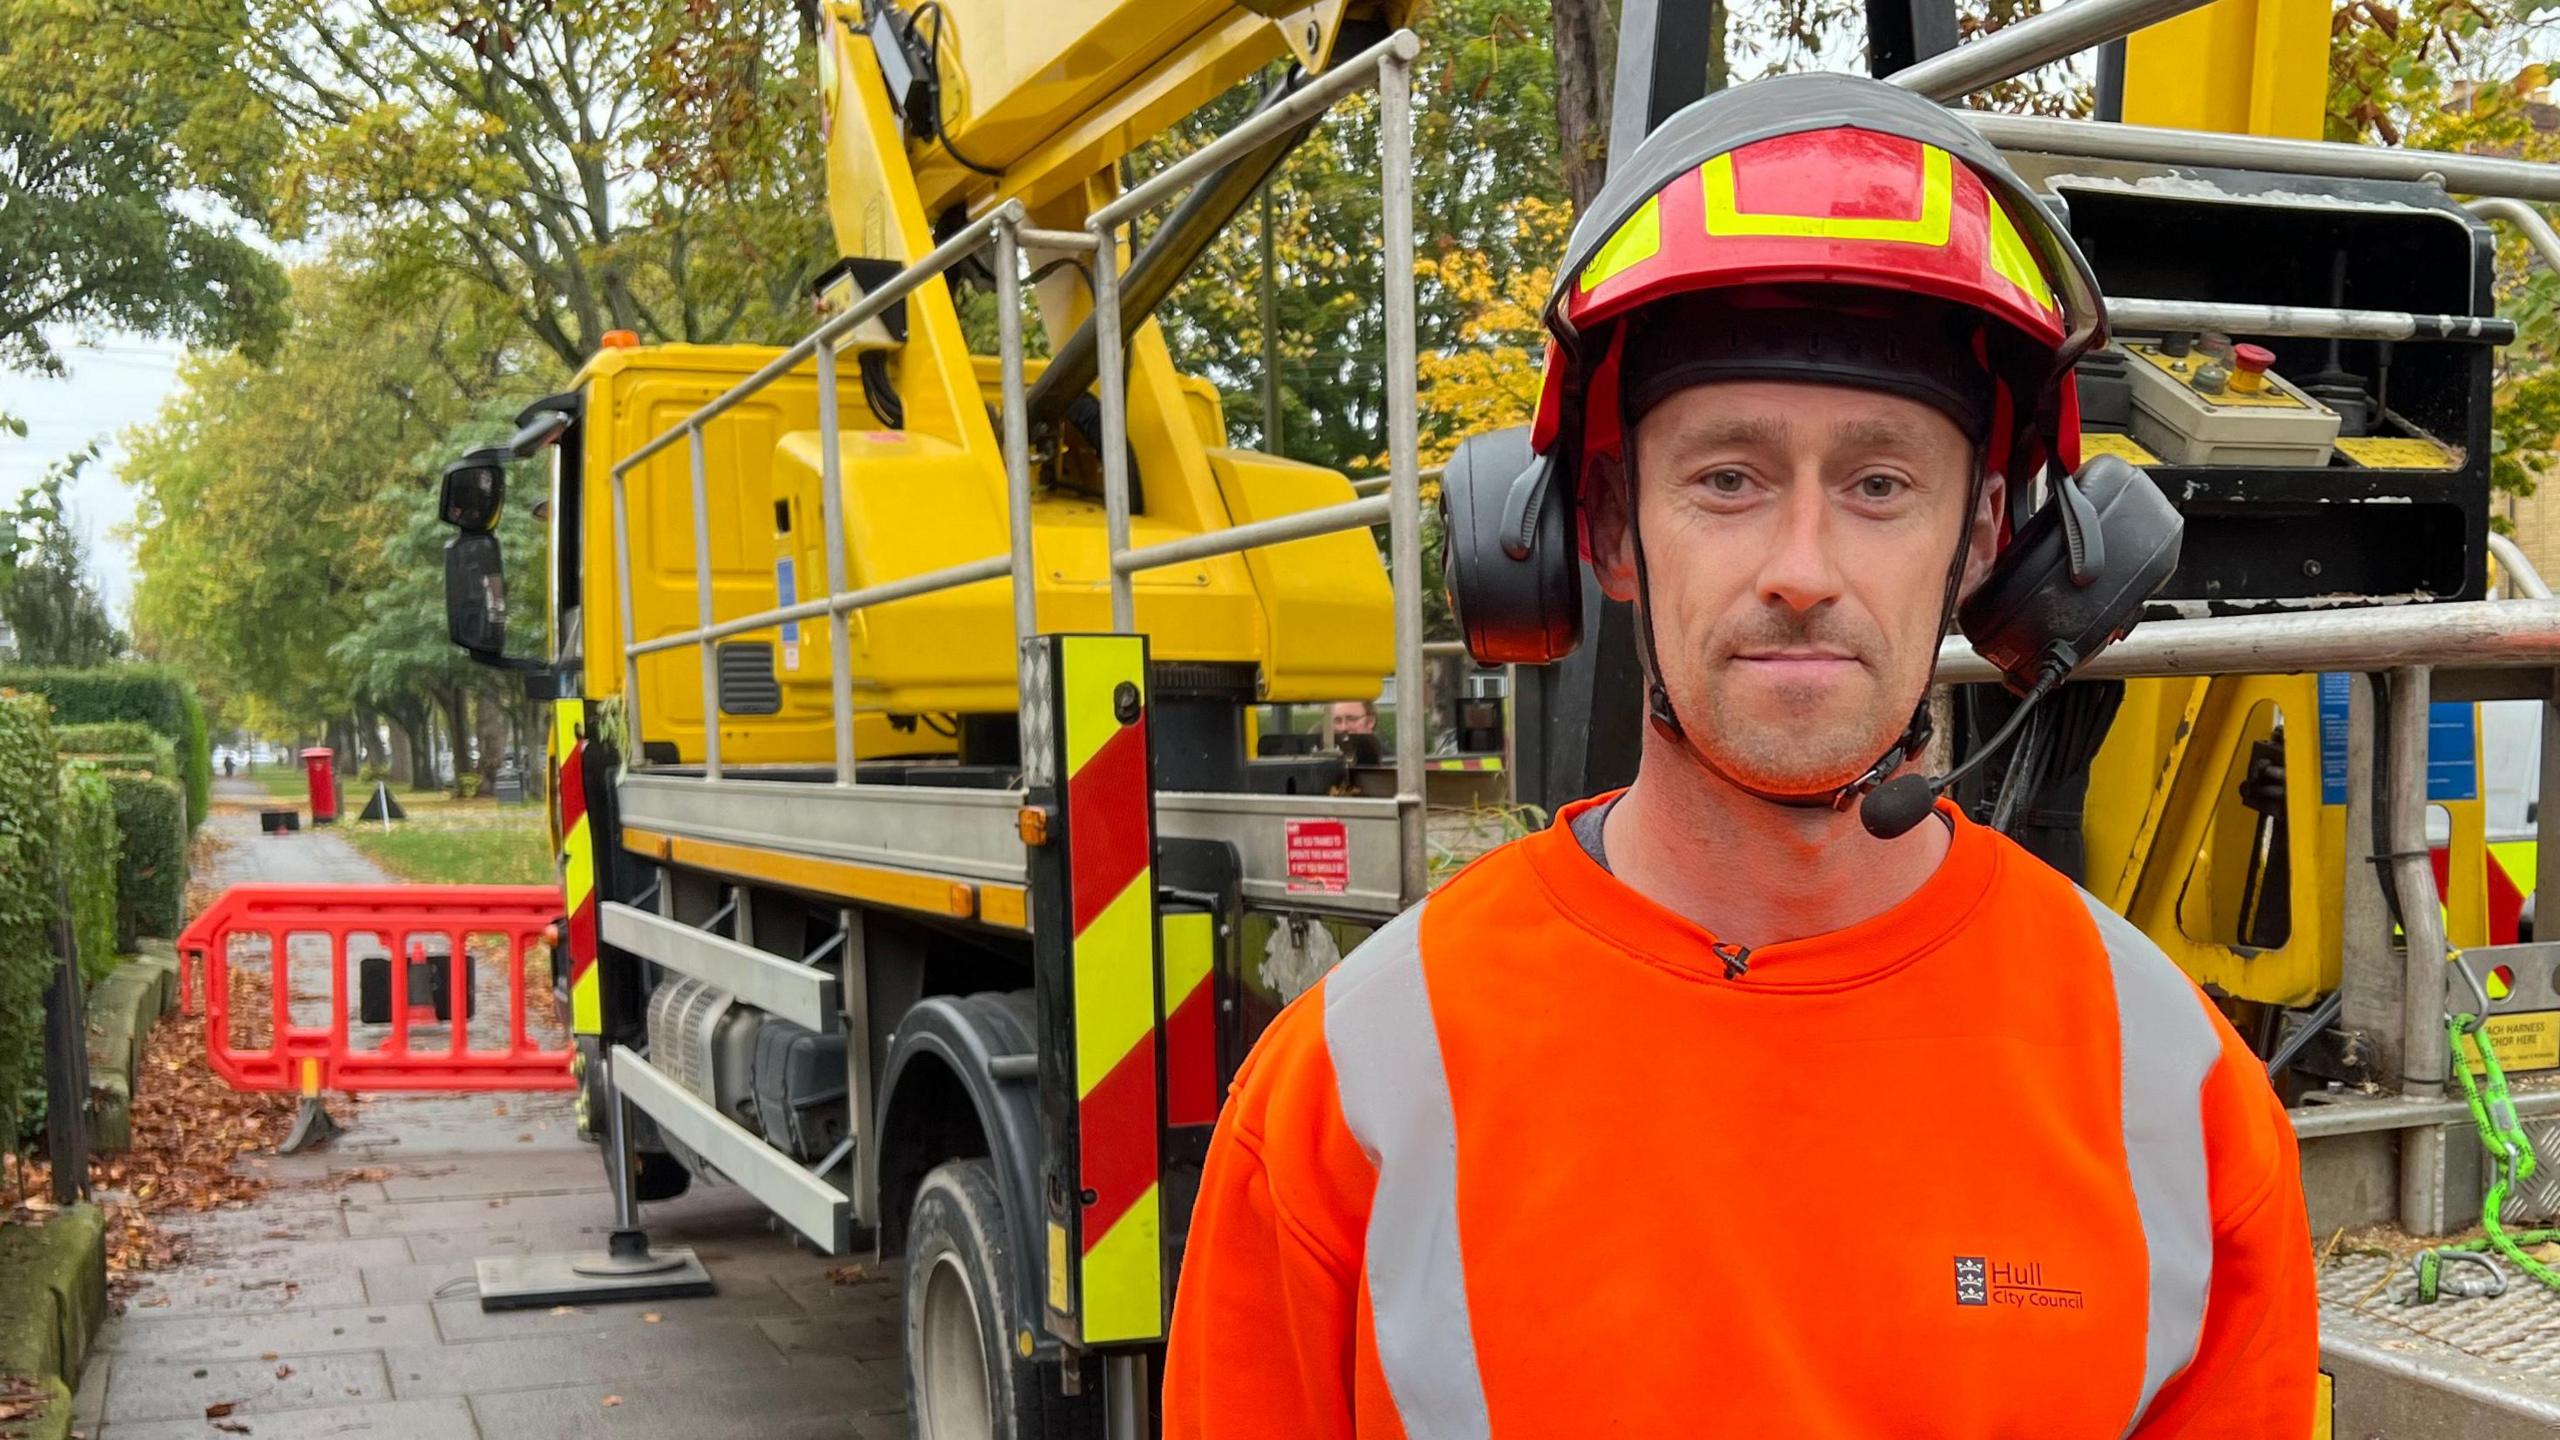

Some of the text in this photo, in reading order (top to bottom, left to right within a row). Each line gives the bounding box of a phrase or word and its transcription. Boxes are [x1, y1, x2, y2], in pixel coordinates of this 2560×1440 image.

[2486, 1022, 2545, 1036] ACH HARNESS
[2491, 1034, 2537, 1047] CHOR HERE
[1991, 1261, 2042, 1286] Hull
[1992, 1289, 2084, 1309] City Council
